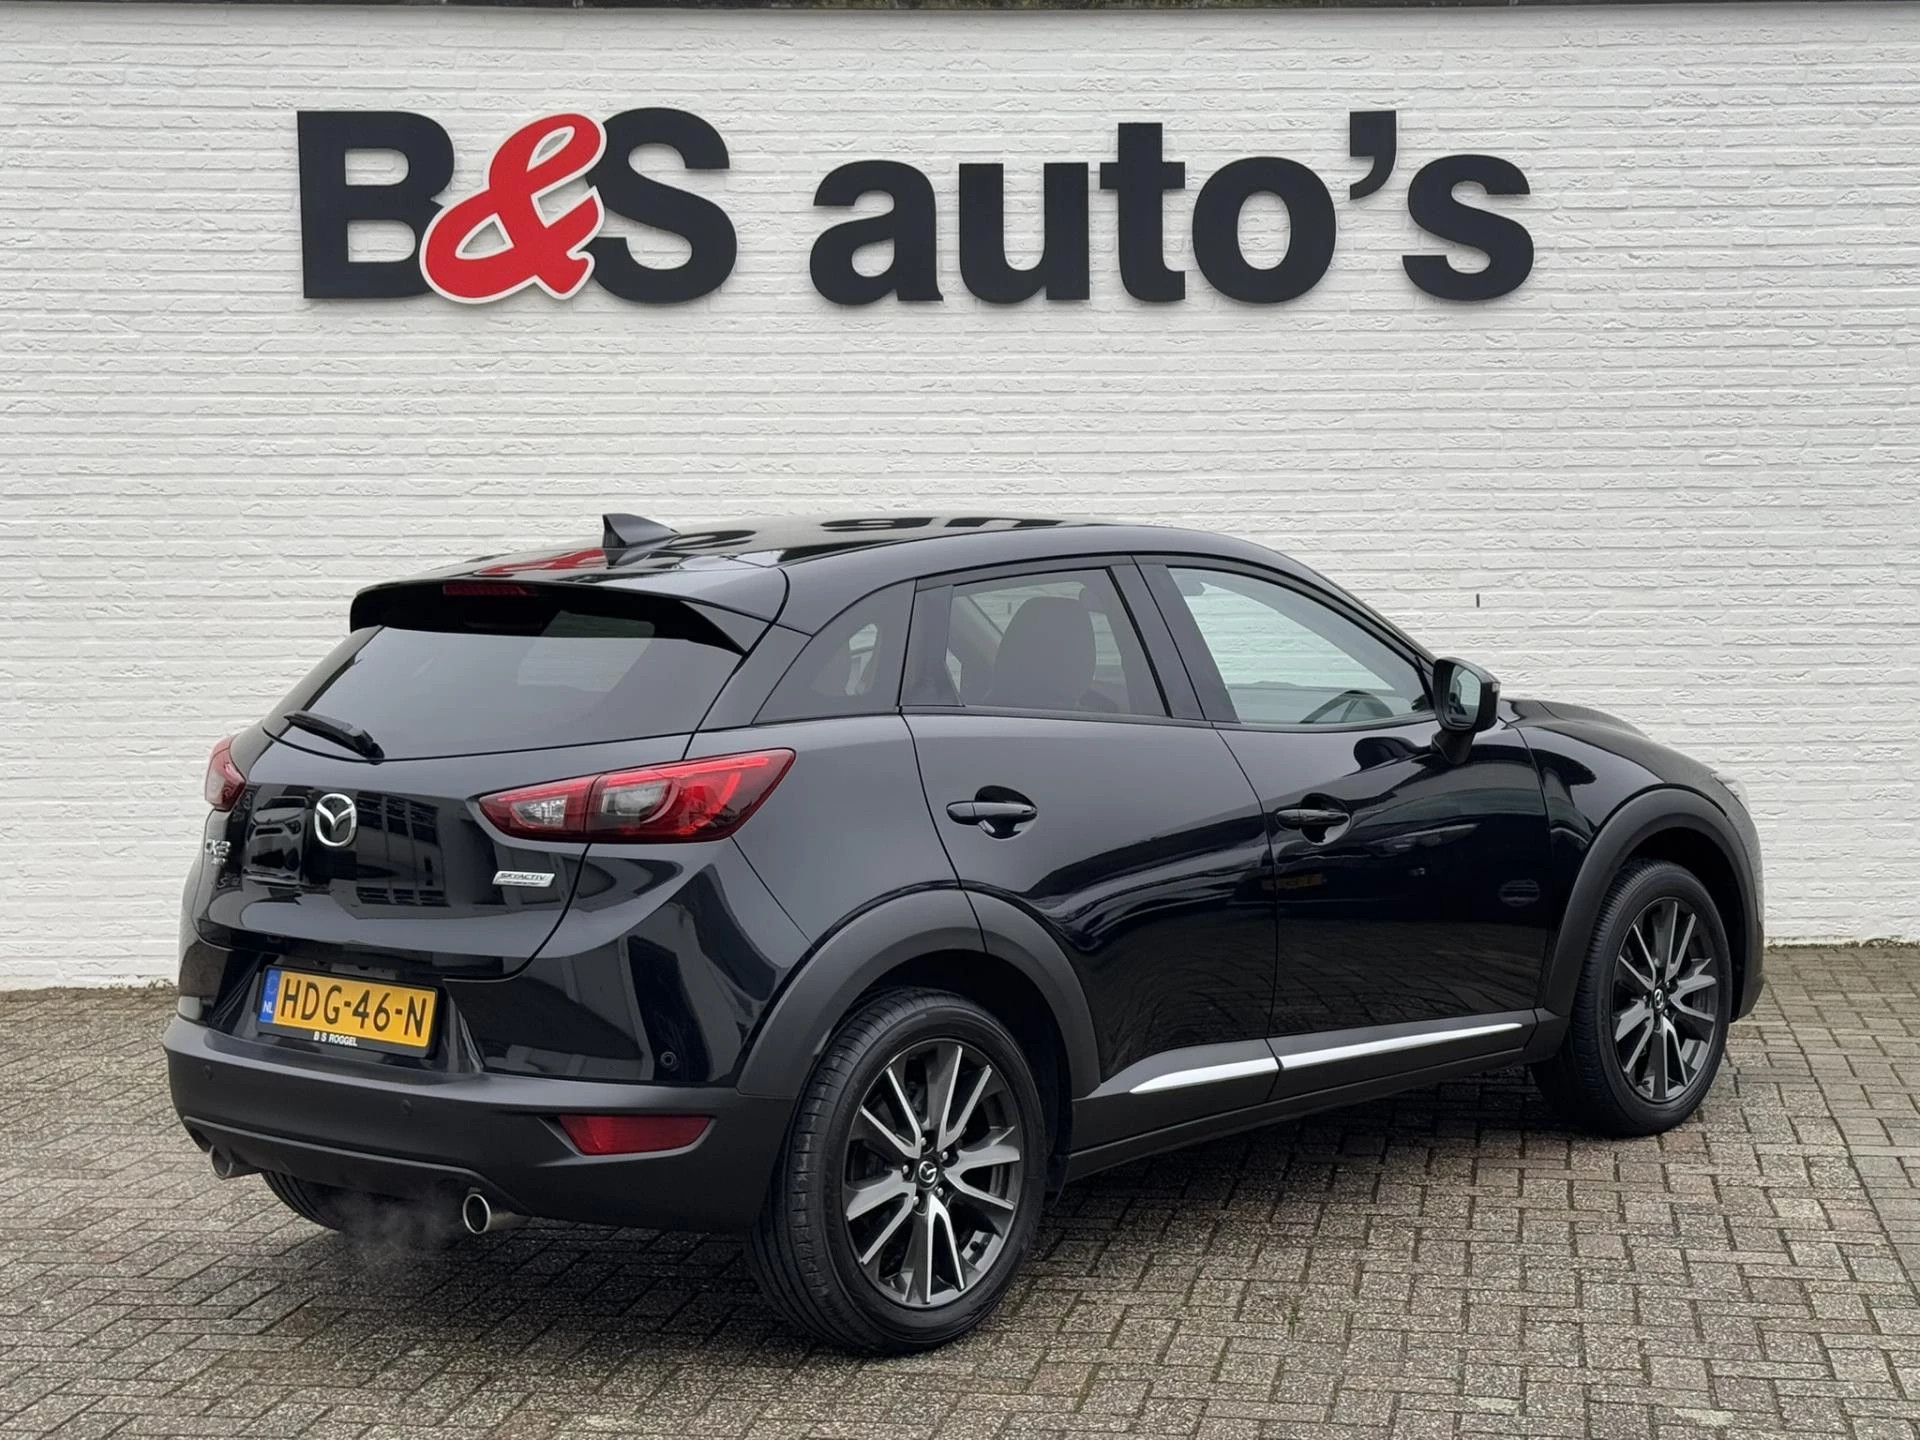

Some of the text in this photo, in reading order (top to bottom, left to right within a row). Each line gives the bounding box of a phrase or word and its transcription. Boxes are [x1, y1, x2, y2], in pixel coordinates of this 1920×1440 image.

[297, 107, 737, 305] B&S
[262, 1000, 274, 1014] NL
[280, 978, 427, 1038] HDG-46-N
